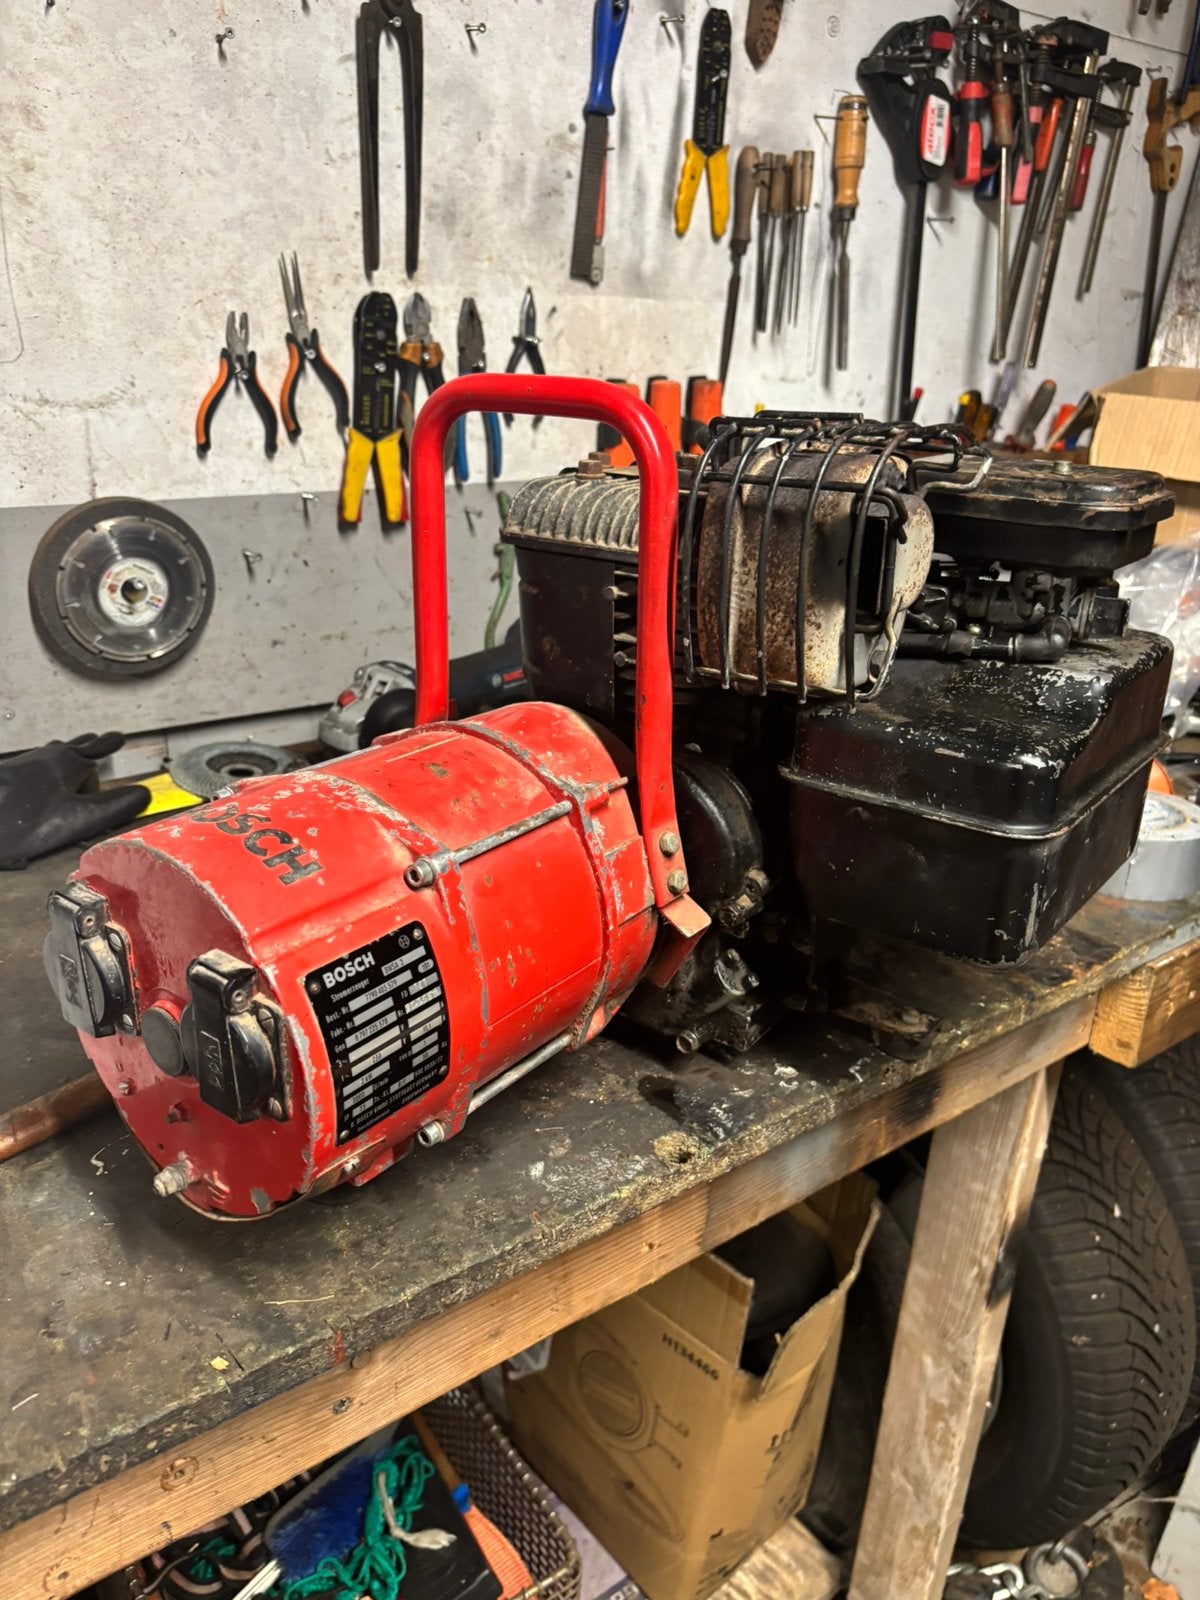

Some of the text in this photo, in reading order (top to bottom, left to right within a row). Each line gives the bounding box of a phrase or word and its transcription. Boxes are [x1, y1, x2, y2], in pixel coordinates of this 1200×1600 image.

[322, 952, 376, 988] BOSCH
[330, 978, 370, 1003] Stromerzeuger
[334, 1043, 346, 1054] Gen
[356, 1112, 374, 1125] BOSCH
